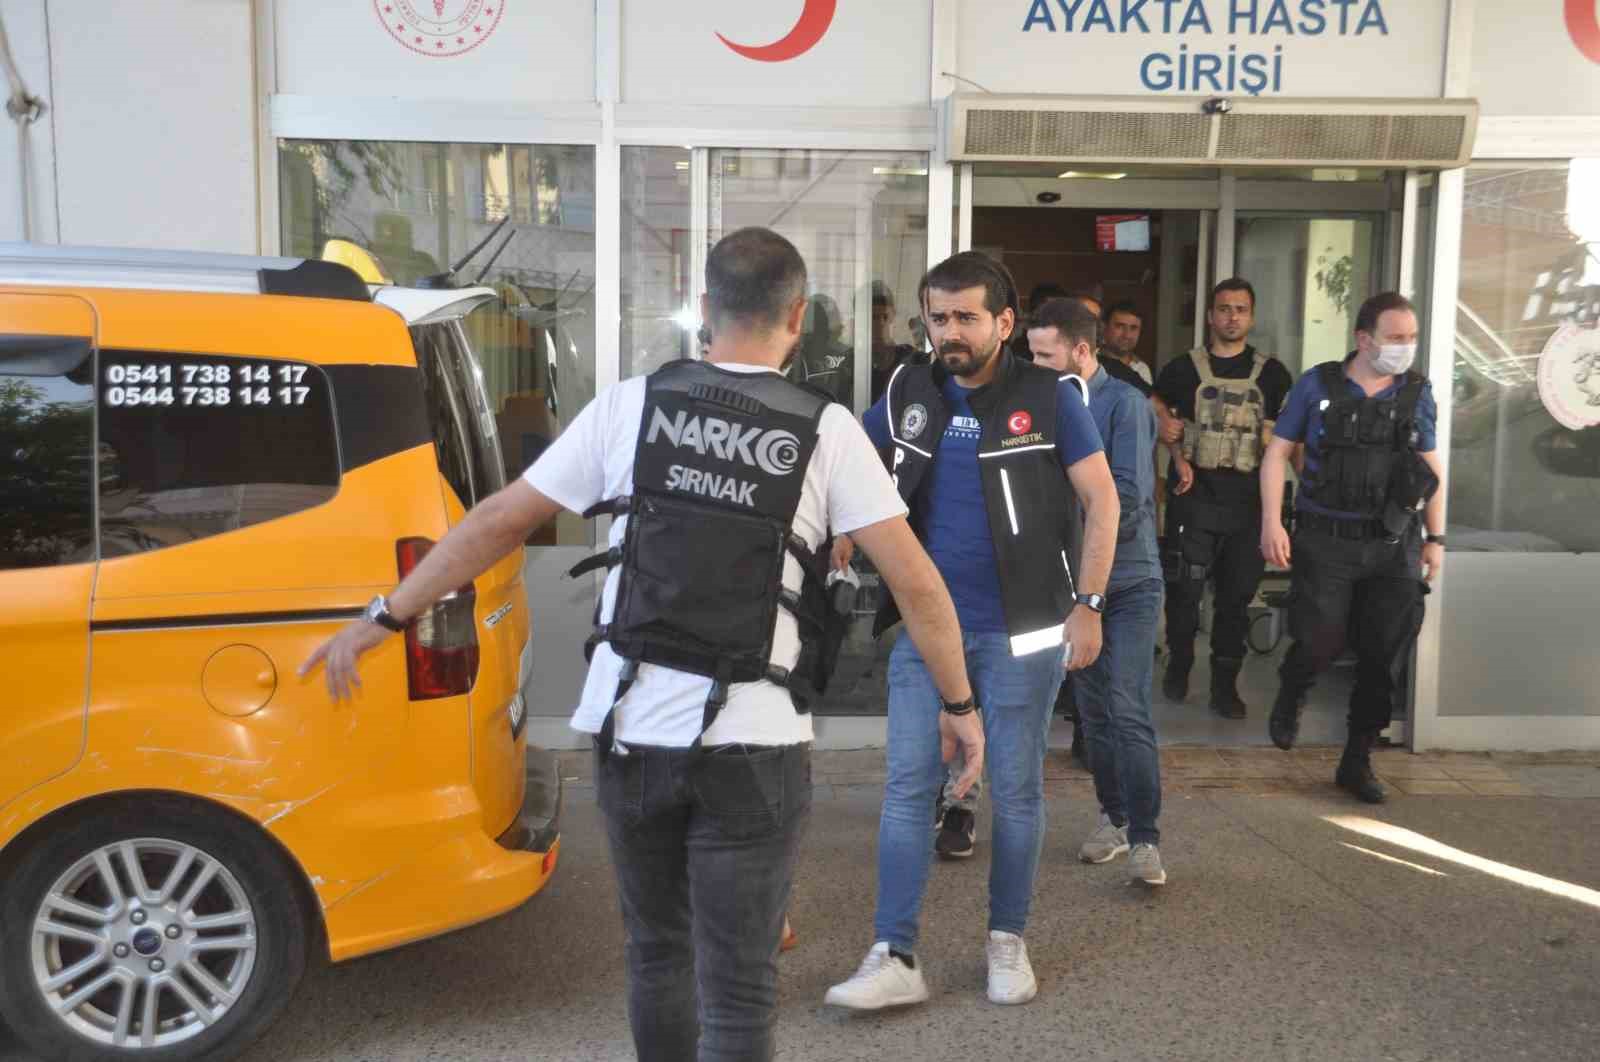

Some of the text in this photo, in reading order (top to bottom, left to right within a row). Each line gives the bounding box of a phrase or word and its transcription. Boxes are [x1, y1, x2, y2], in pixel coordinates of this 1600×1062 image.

[1022, 0, 1389, 36] AYAKTA HASTA
[1140, 44, 1282, 96] GİRİŞİ
[107, 365, 308, 384] 0541 738 14 17
[107, 386, 311, 405] 0544 738 14 17
[645, 405, 801, 476] NARKO
